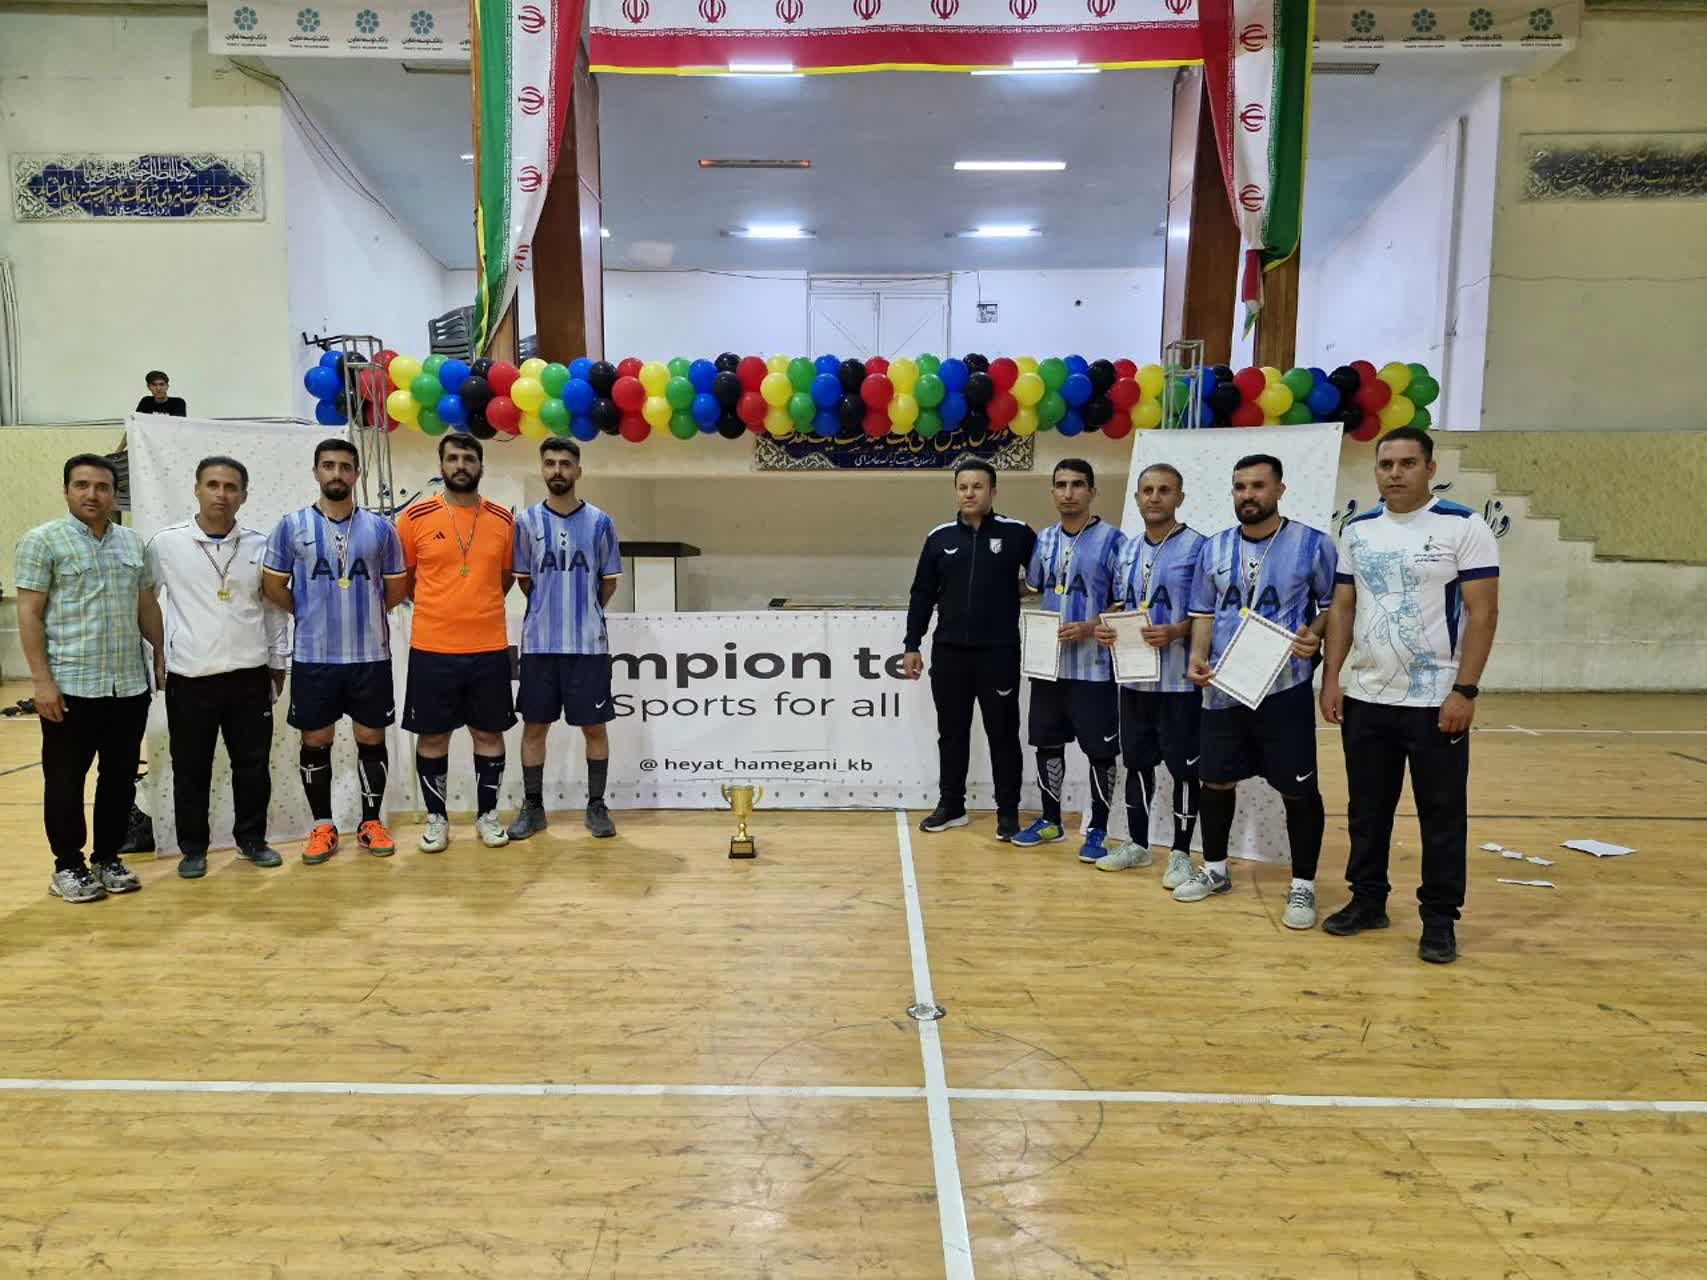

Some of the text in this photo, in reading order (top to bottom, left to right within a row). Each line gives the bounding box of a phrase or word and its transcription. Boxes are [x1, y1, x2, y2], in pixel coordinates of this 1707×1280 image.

[311, 558, 371, 580] AIA
[540, 550, 590, 573] AIA
[1221, 585, 1280, 611] AIA
[609, 642, 908, 688] mpion te
[613, 691, 899, 722] Sports for all
